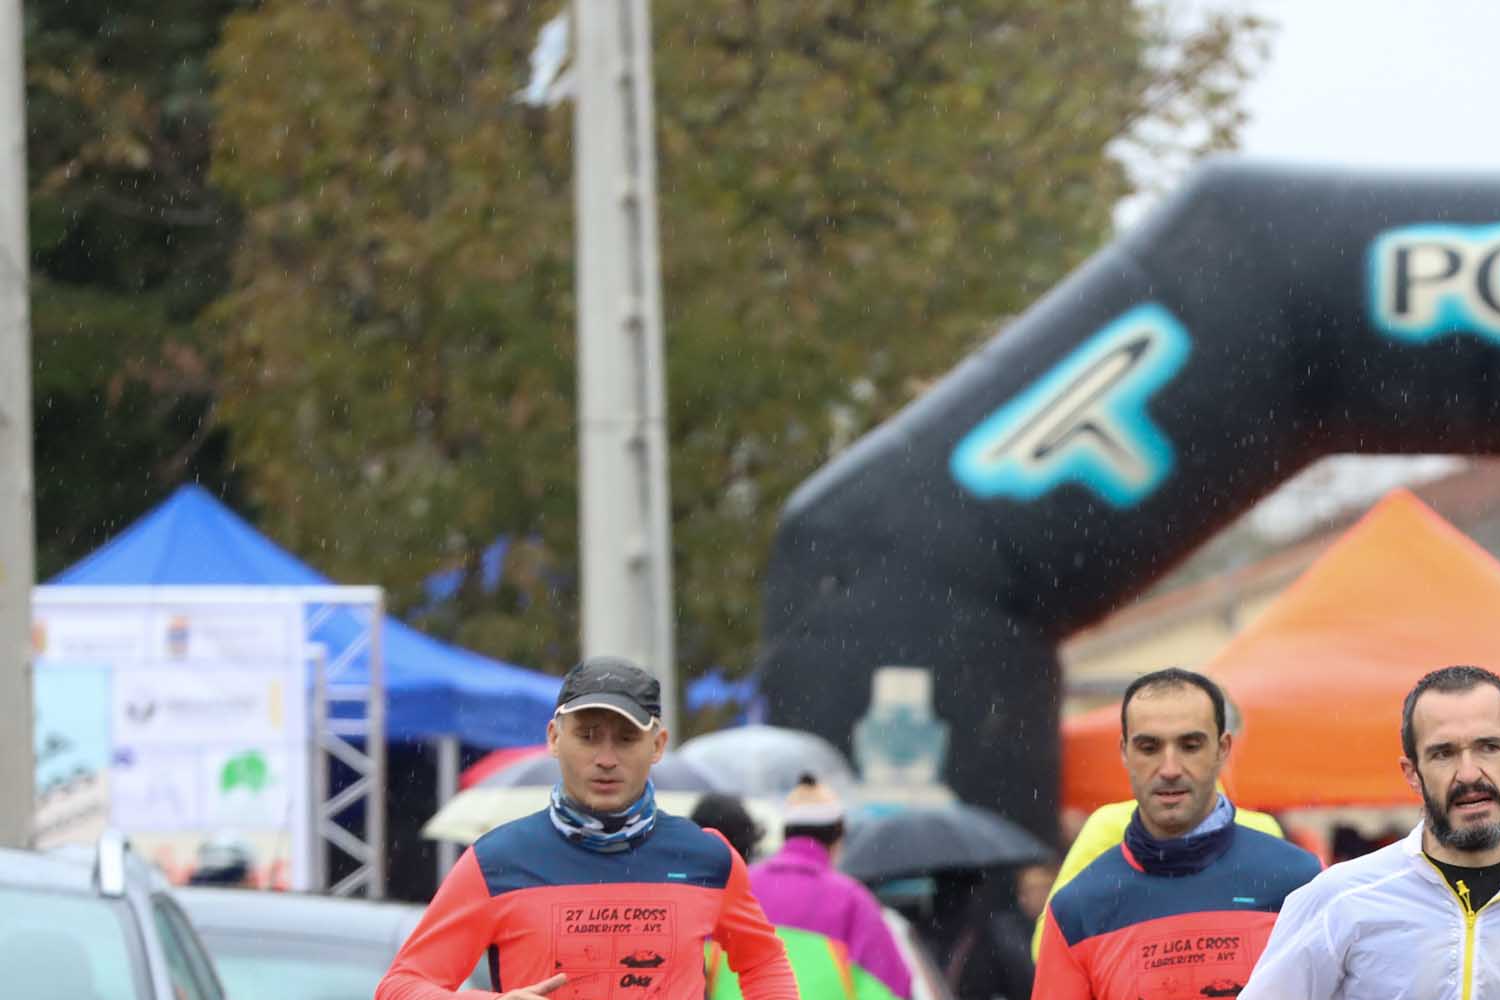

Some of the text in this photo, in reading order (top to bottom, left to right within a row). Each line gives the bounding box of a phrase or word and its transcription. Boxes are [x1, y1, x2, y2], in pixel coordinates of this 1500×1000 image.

[565, 908, 667, 921] 27 LIGA CROSS
[567, 923, 632, 934] CABRERIZOS
[1142, 937, 1240, 958] 27 LIGA CROSS
